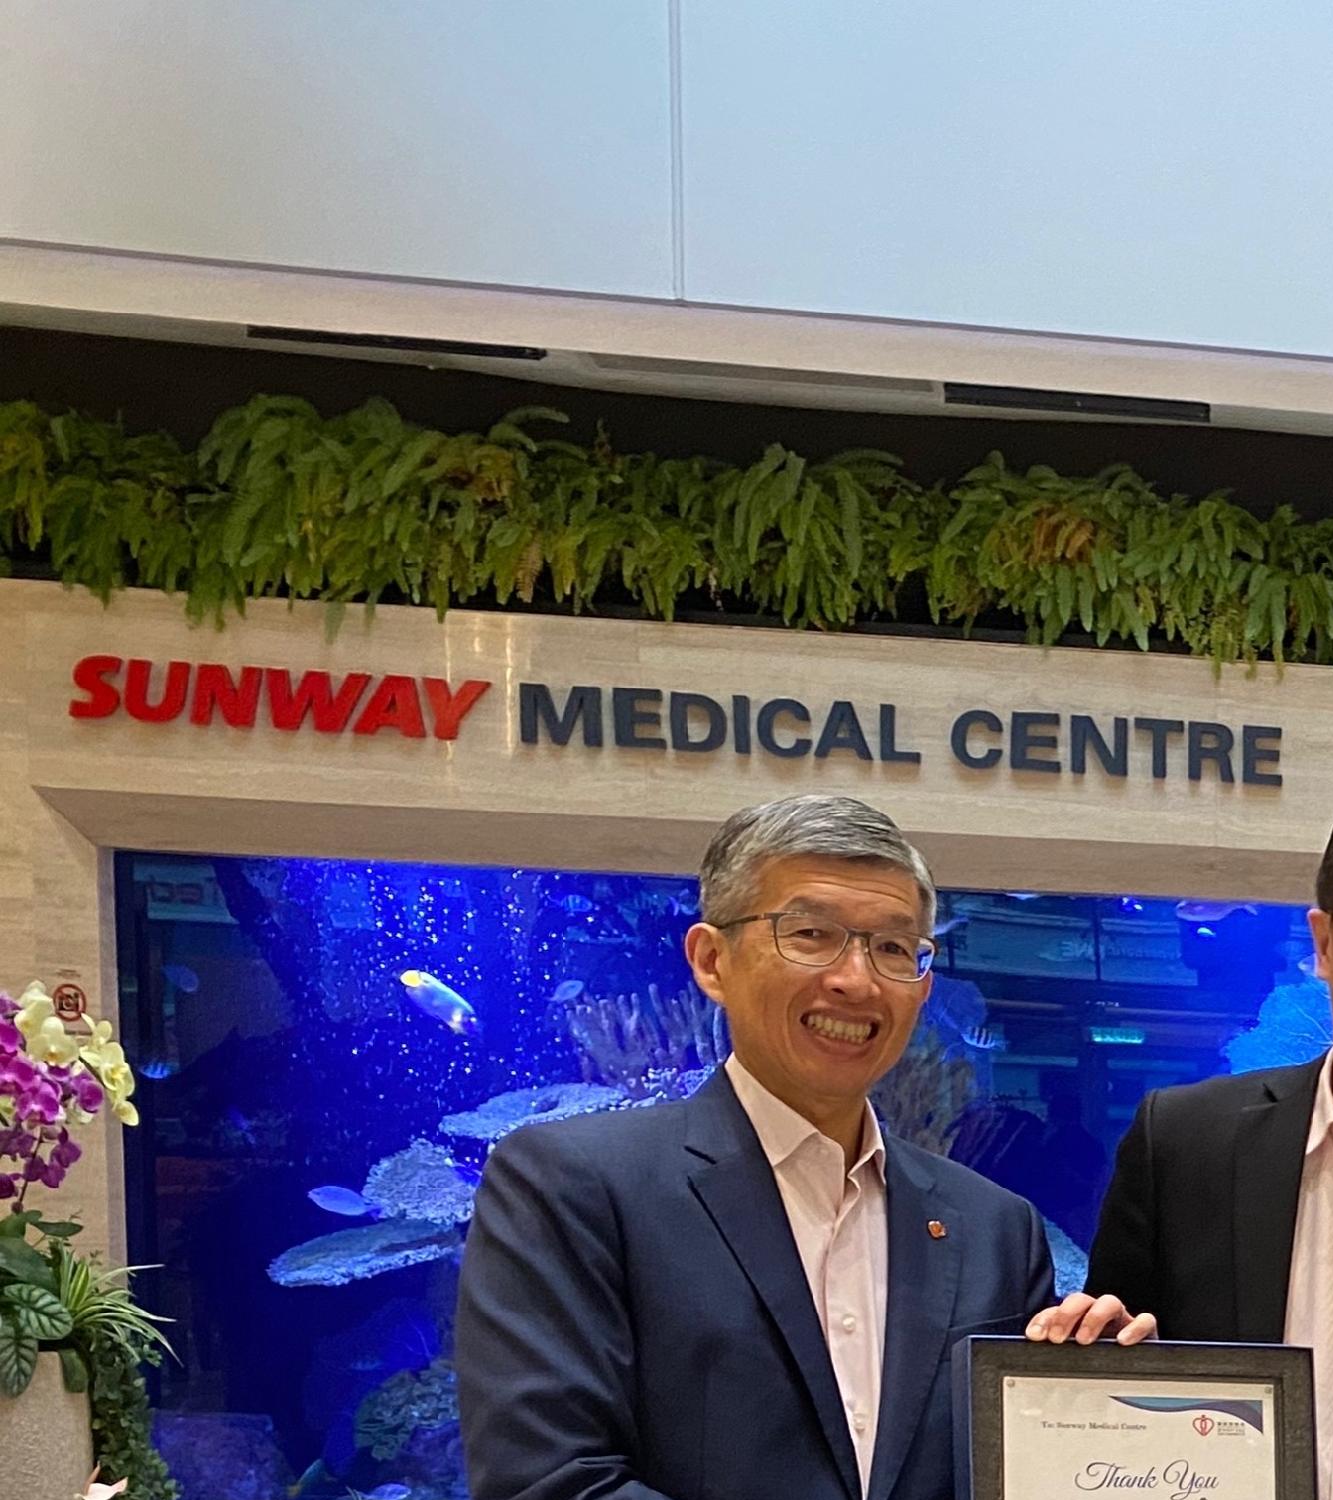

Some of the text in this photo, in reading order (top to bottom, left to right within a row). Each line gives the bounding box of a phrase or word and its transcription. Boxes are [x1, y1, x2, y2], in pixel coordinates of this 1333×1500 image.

[69, 654, 1283, 787] SUNWAY MEDICAL CENTRE
[1074, 1459, 1219, 1500] Thank You
